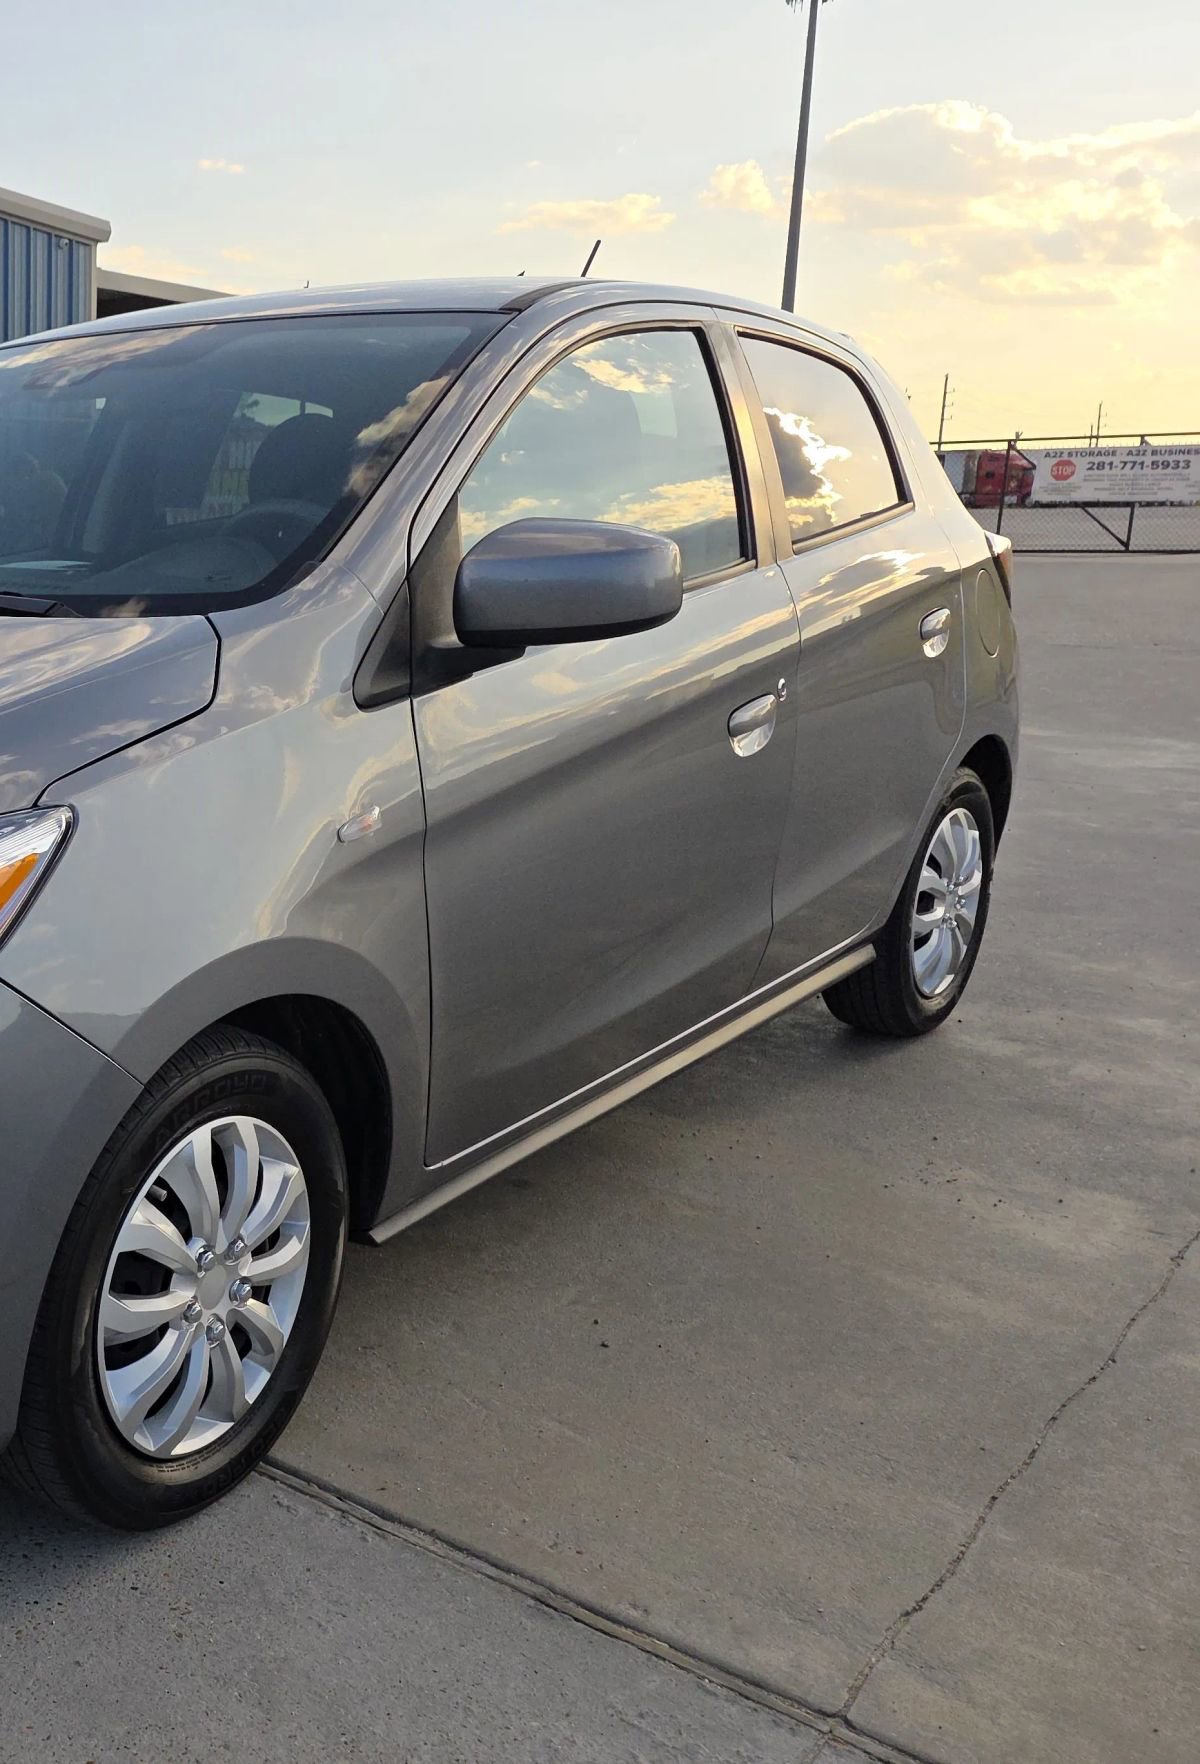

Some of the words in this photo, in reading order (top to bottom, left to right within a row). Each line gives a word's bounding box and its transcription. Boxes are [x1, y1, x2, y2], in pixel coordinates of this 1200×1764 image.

[1067, 449, 1117, 458] STORAGE
[1051, 465, 1076, 476] STOP
[1086, 459, 1191, 471] 281-771-5933
